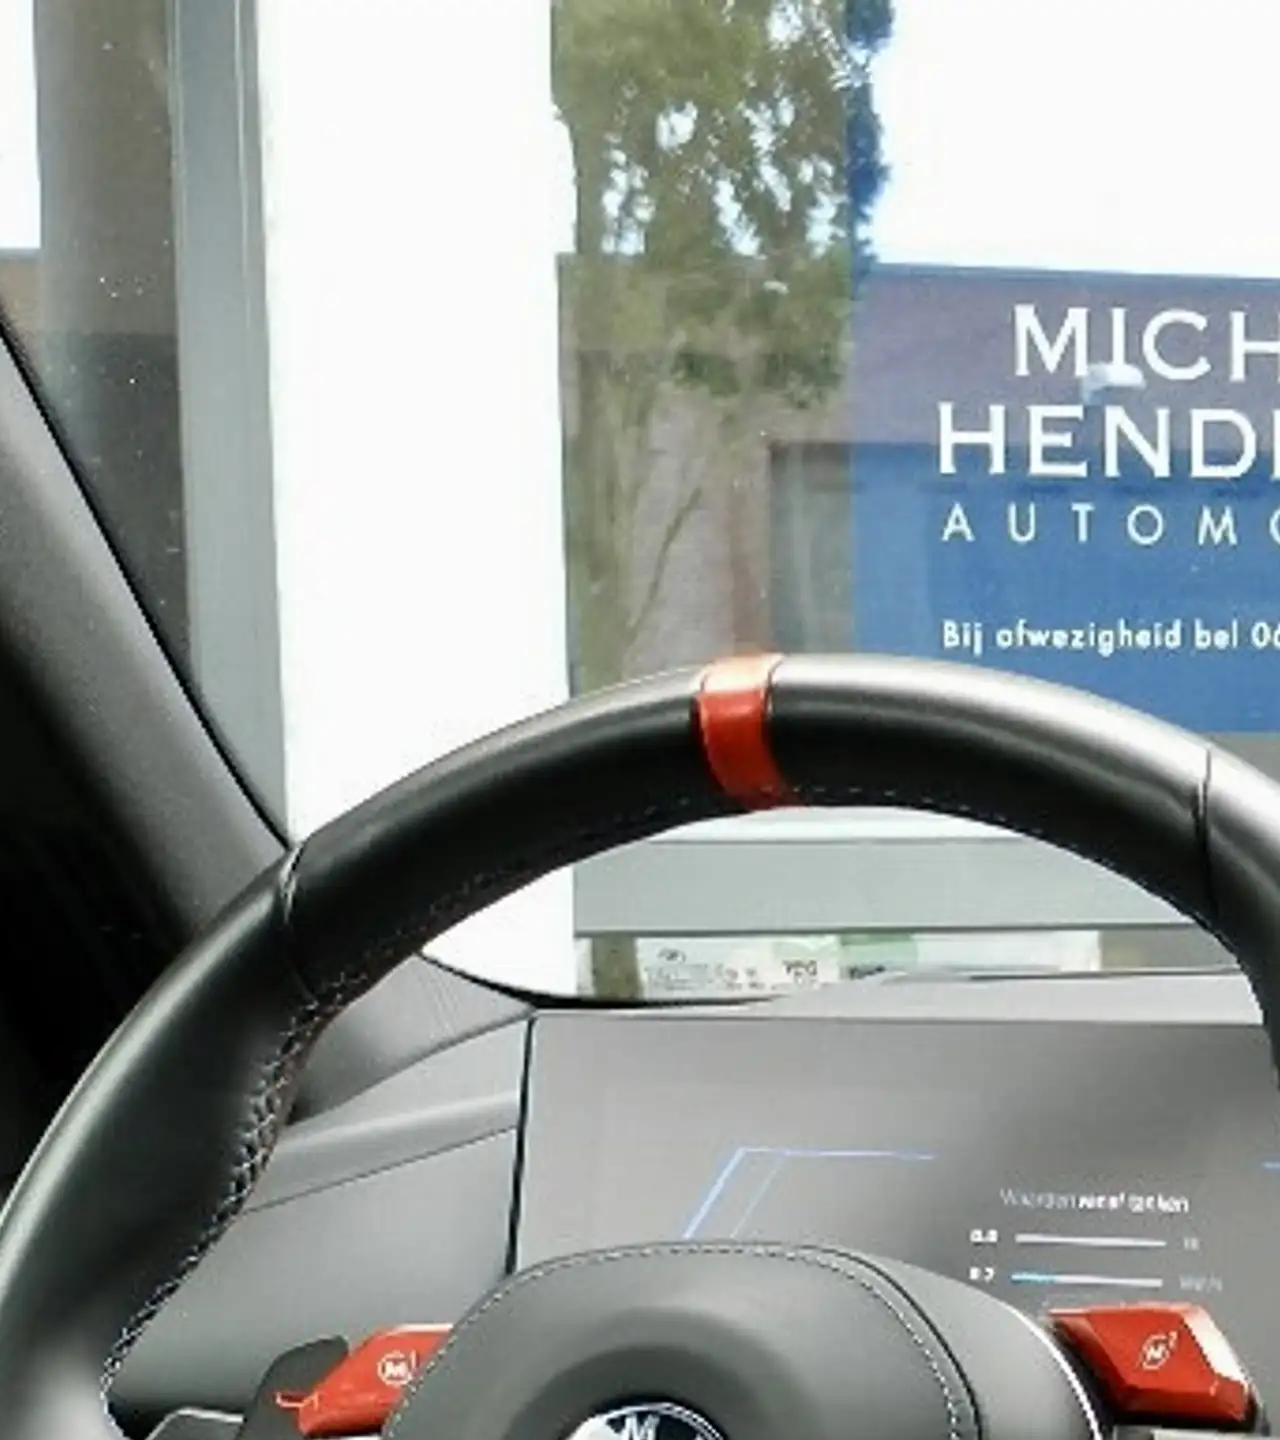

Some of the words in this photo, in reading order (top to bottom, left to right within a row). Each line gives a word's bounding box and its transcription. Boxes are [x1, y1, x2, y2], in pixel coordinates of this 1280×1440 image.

[942, 618, 983, 658] Bij
[995, 617, 1182, 658] afwezigheid
[1193, 618, 1238, 650] bel
